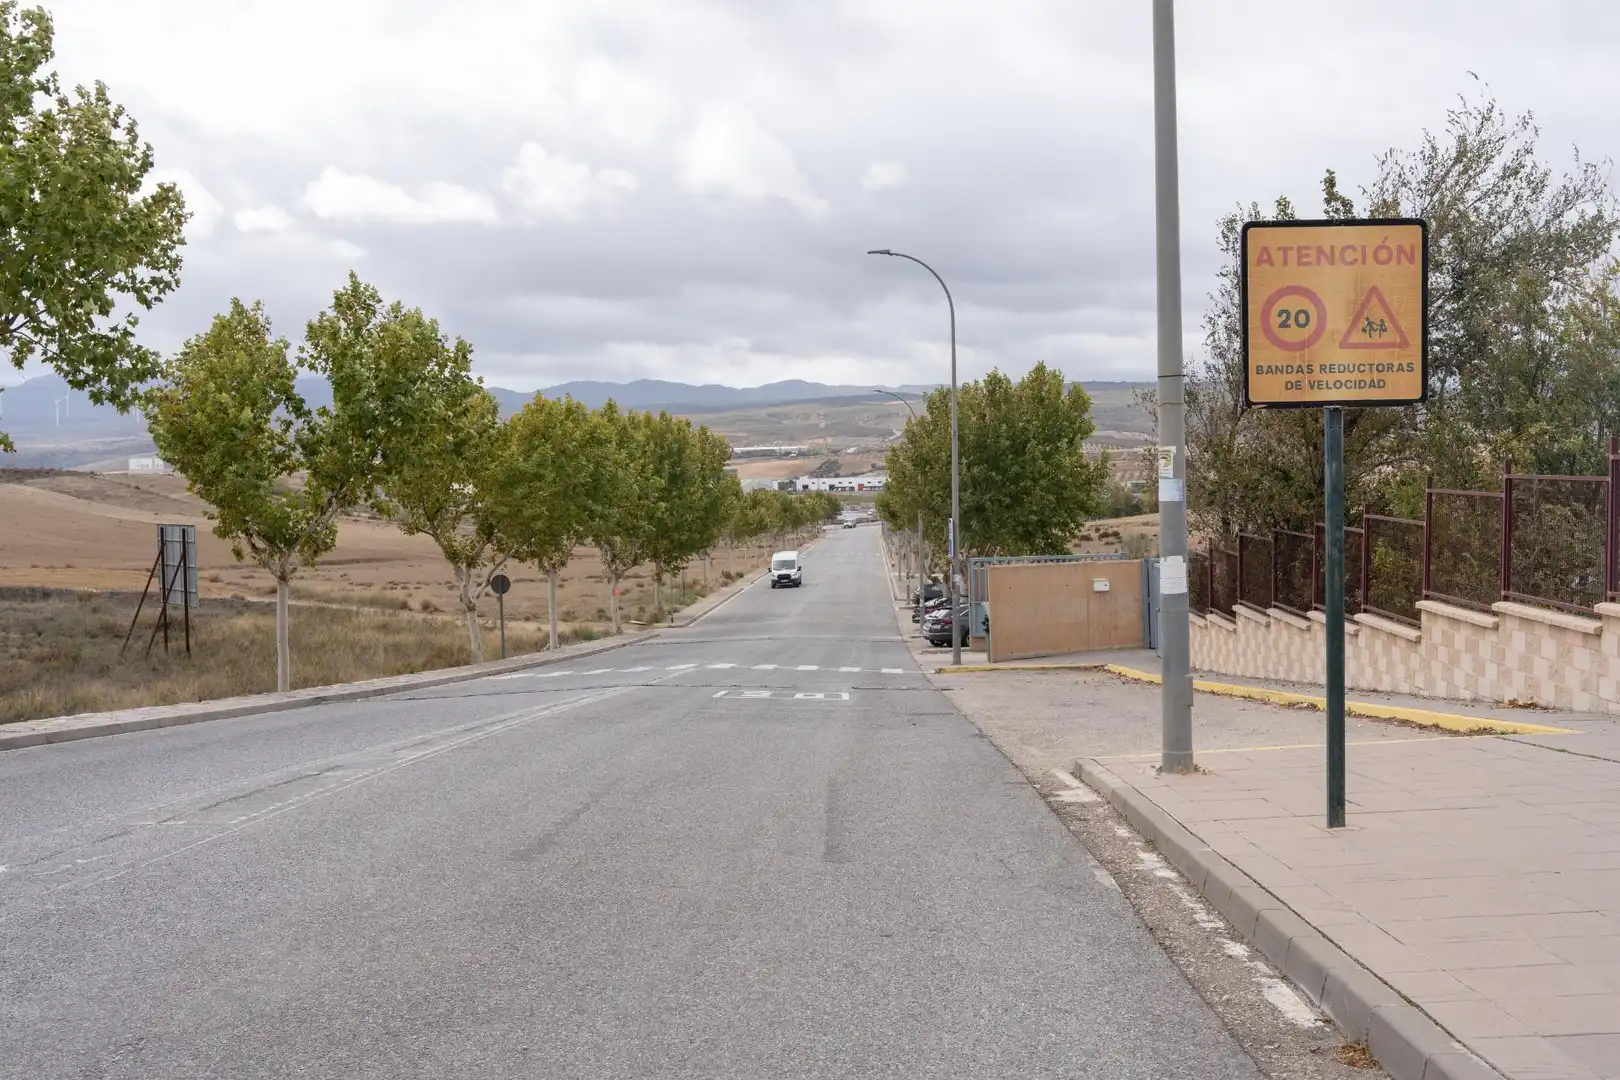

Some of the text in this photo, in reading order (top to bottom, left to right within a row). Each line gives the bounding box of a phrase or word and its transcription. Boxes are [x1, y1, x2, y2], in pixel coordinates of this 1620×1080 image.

[1255, 236, 1416, 267] ATENCIÓN
[1277, 308, 1310, 329] 20
[1256, 362, 1415, 375] BANDAS REDUCTORAS
[1285, 378, 1386, 391] DE VELOCIDAD
